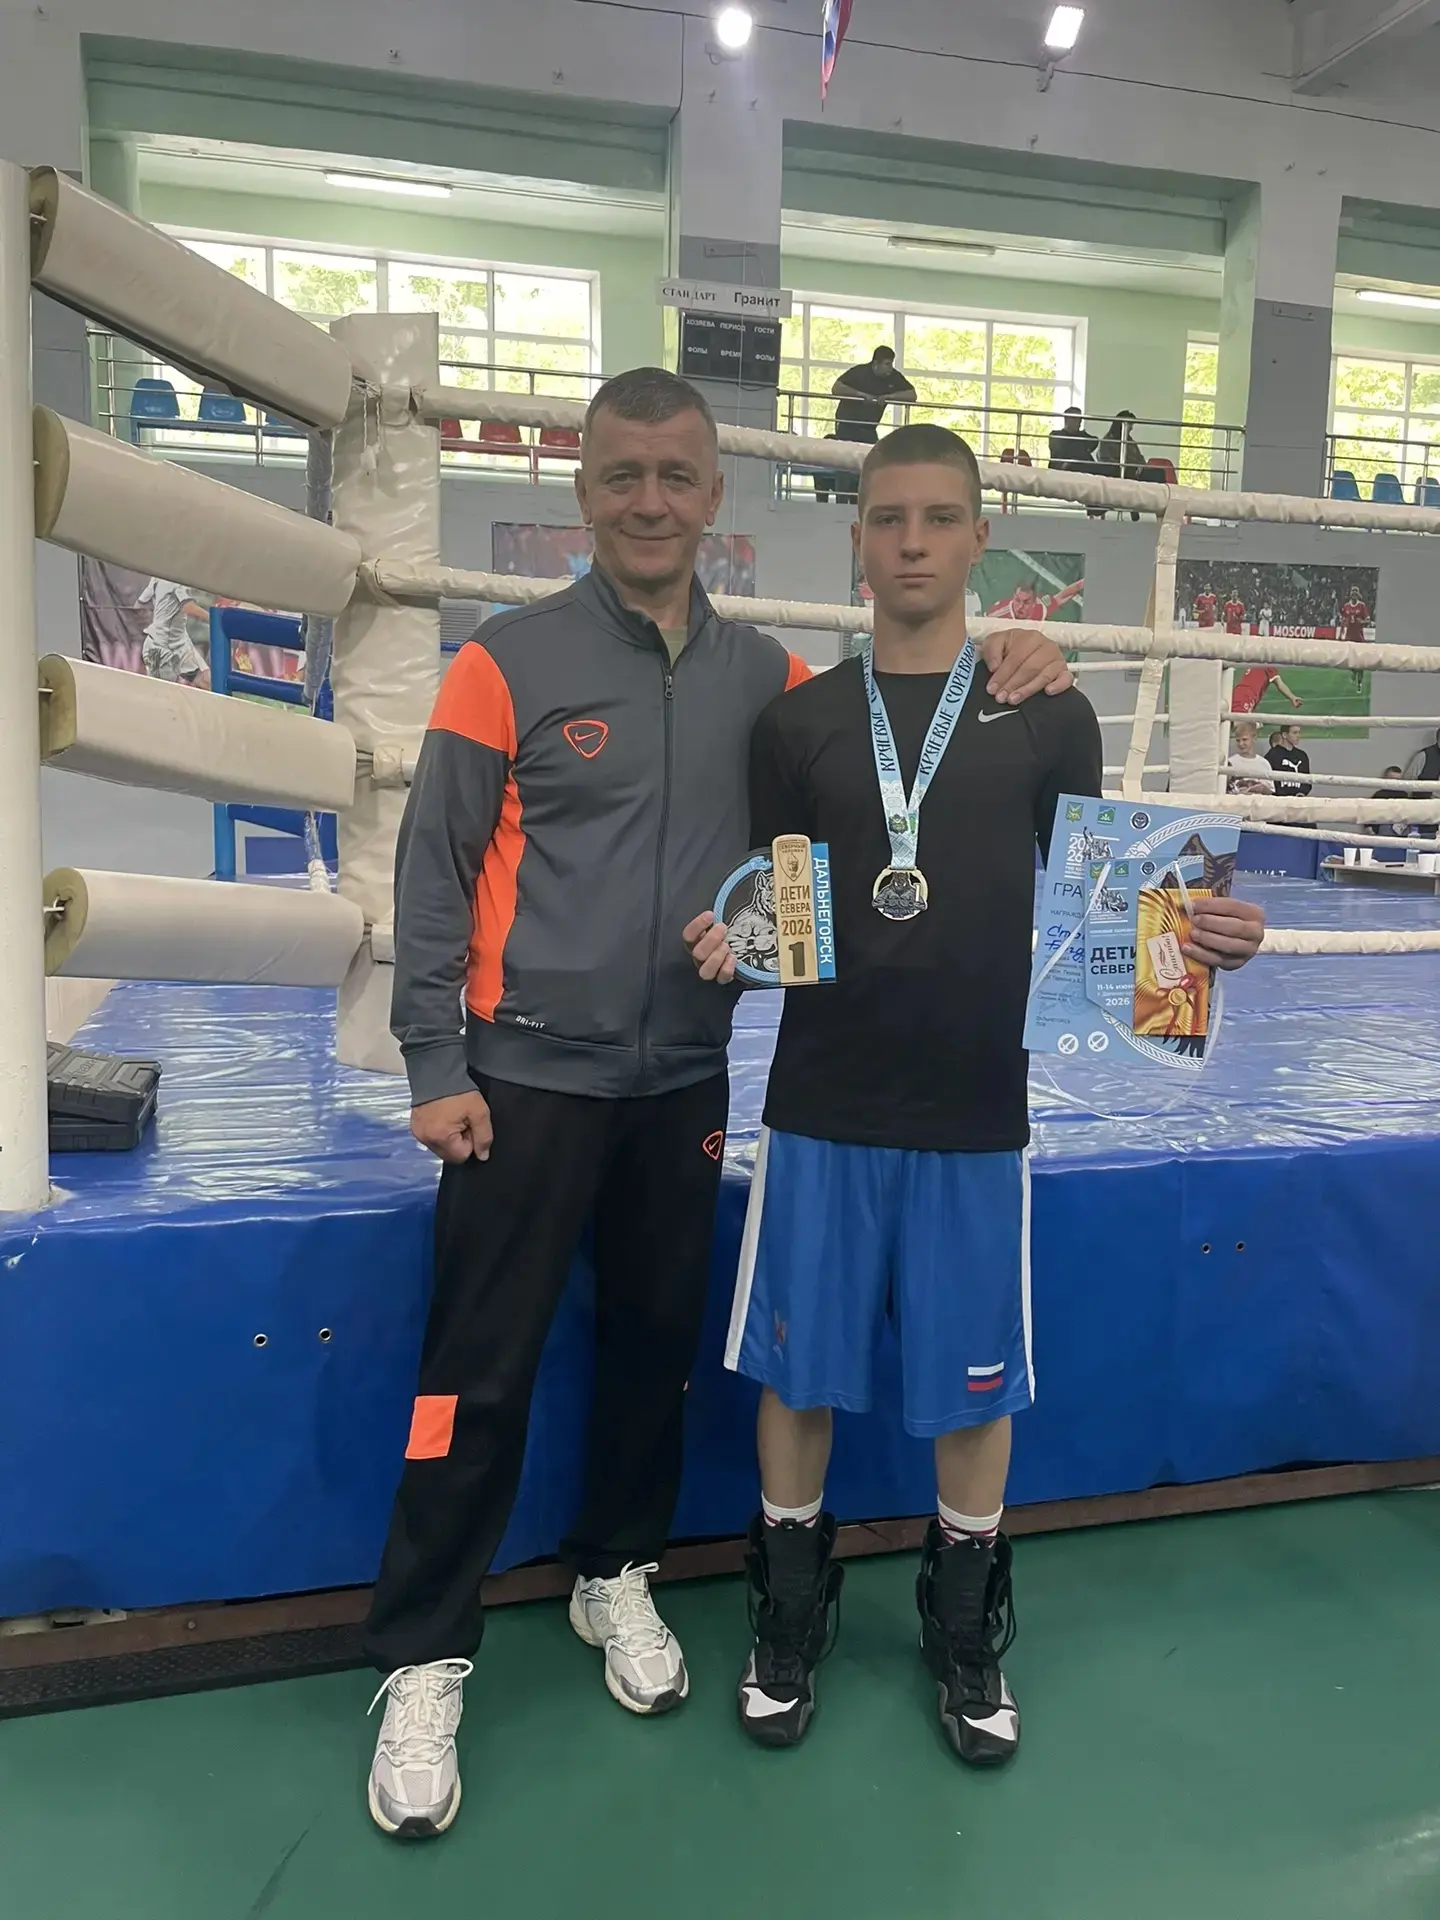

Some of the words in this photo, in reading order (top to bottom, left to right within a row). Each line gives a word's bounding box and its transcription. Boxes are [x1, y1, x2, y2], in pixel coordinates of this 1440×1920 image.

[734, 291, 781, 307] Гранит
[686, 319, 716, 328] ХОЗЯЕВА
[719, 321, 746, 332] ПЕРИОД
[754, 326, 775, 334] ГОСТИ
[1273, 625, 1316, 638] MOSCOW
[1068, 836, 1087, 850] 20
[1066, 849, 1084, 863] 26
[780, 885, 811, 903] ДЕТИ
[780, 902, 812, 914] СЕВЕРА
[813, 858, 832, 963] ДАЛЬНЕГОРСК
[782, 919, 812, 936] 2026
[788, 941, 806, 977] 1
[1105, 997, 1130, 1006] 2026
[515, 1015, 546, 1029] DRI-FIT
